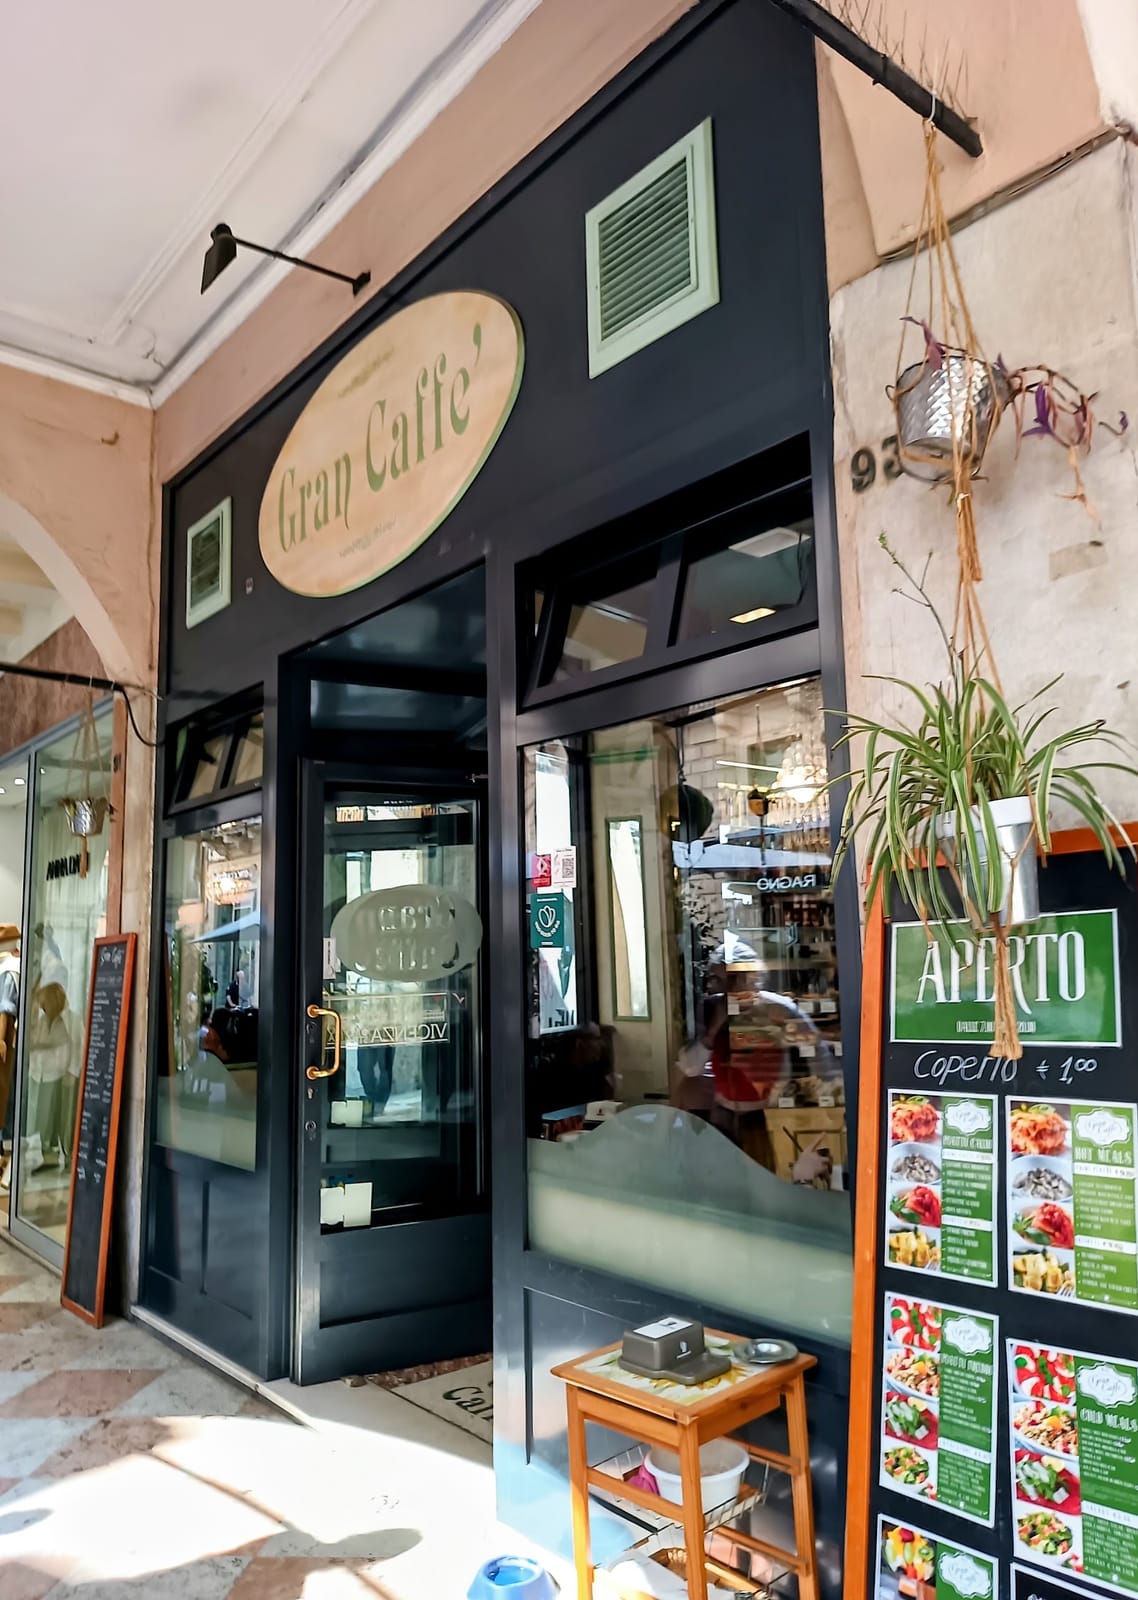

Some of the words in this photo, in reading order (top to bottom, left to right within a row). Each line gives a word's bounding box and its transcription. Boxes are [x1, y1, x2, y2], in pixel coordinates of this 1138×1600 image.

[278, 453, 352, 553] Gran
[916, 931, 1086, 1015] APERTO
[913, 1050, 1018, 1086] Coperto
